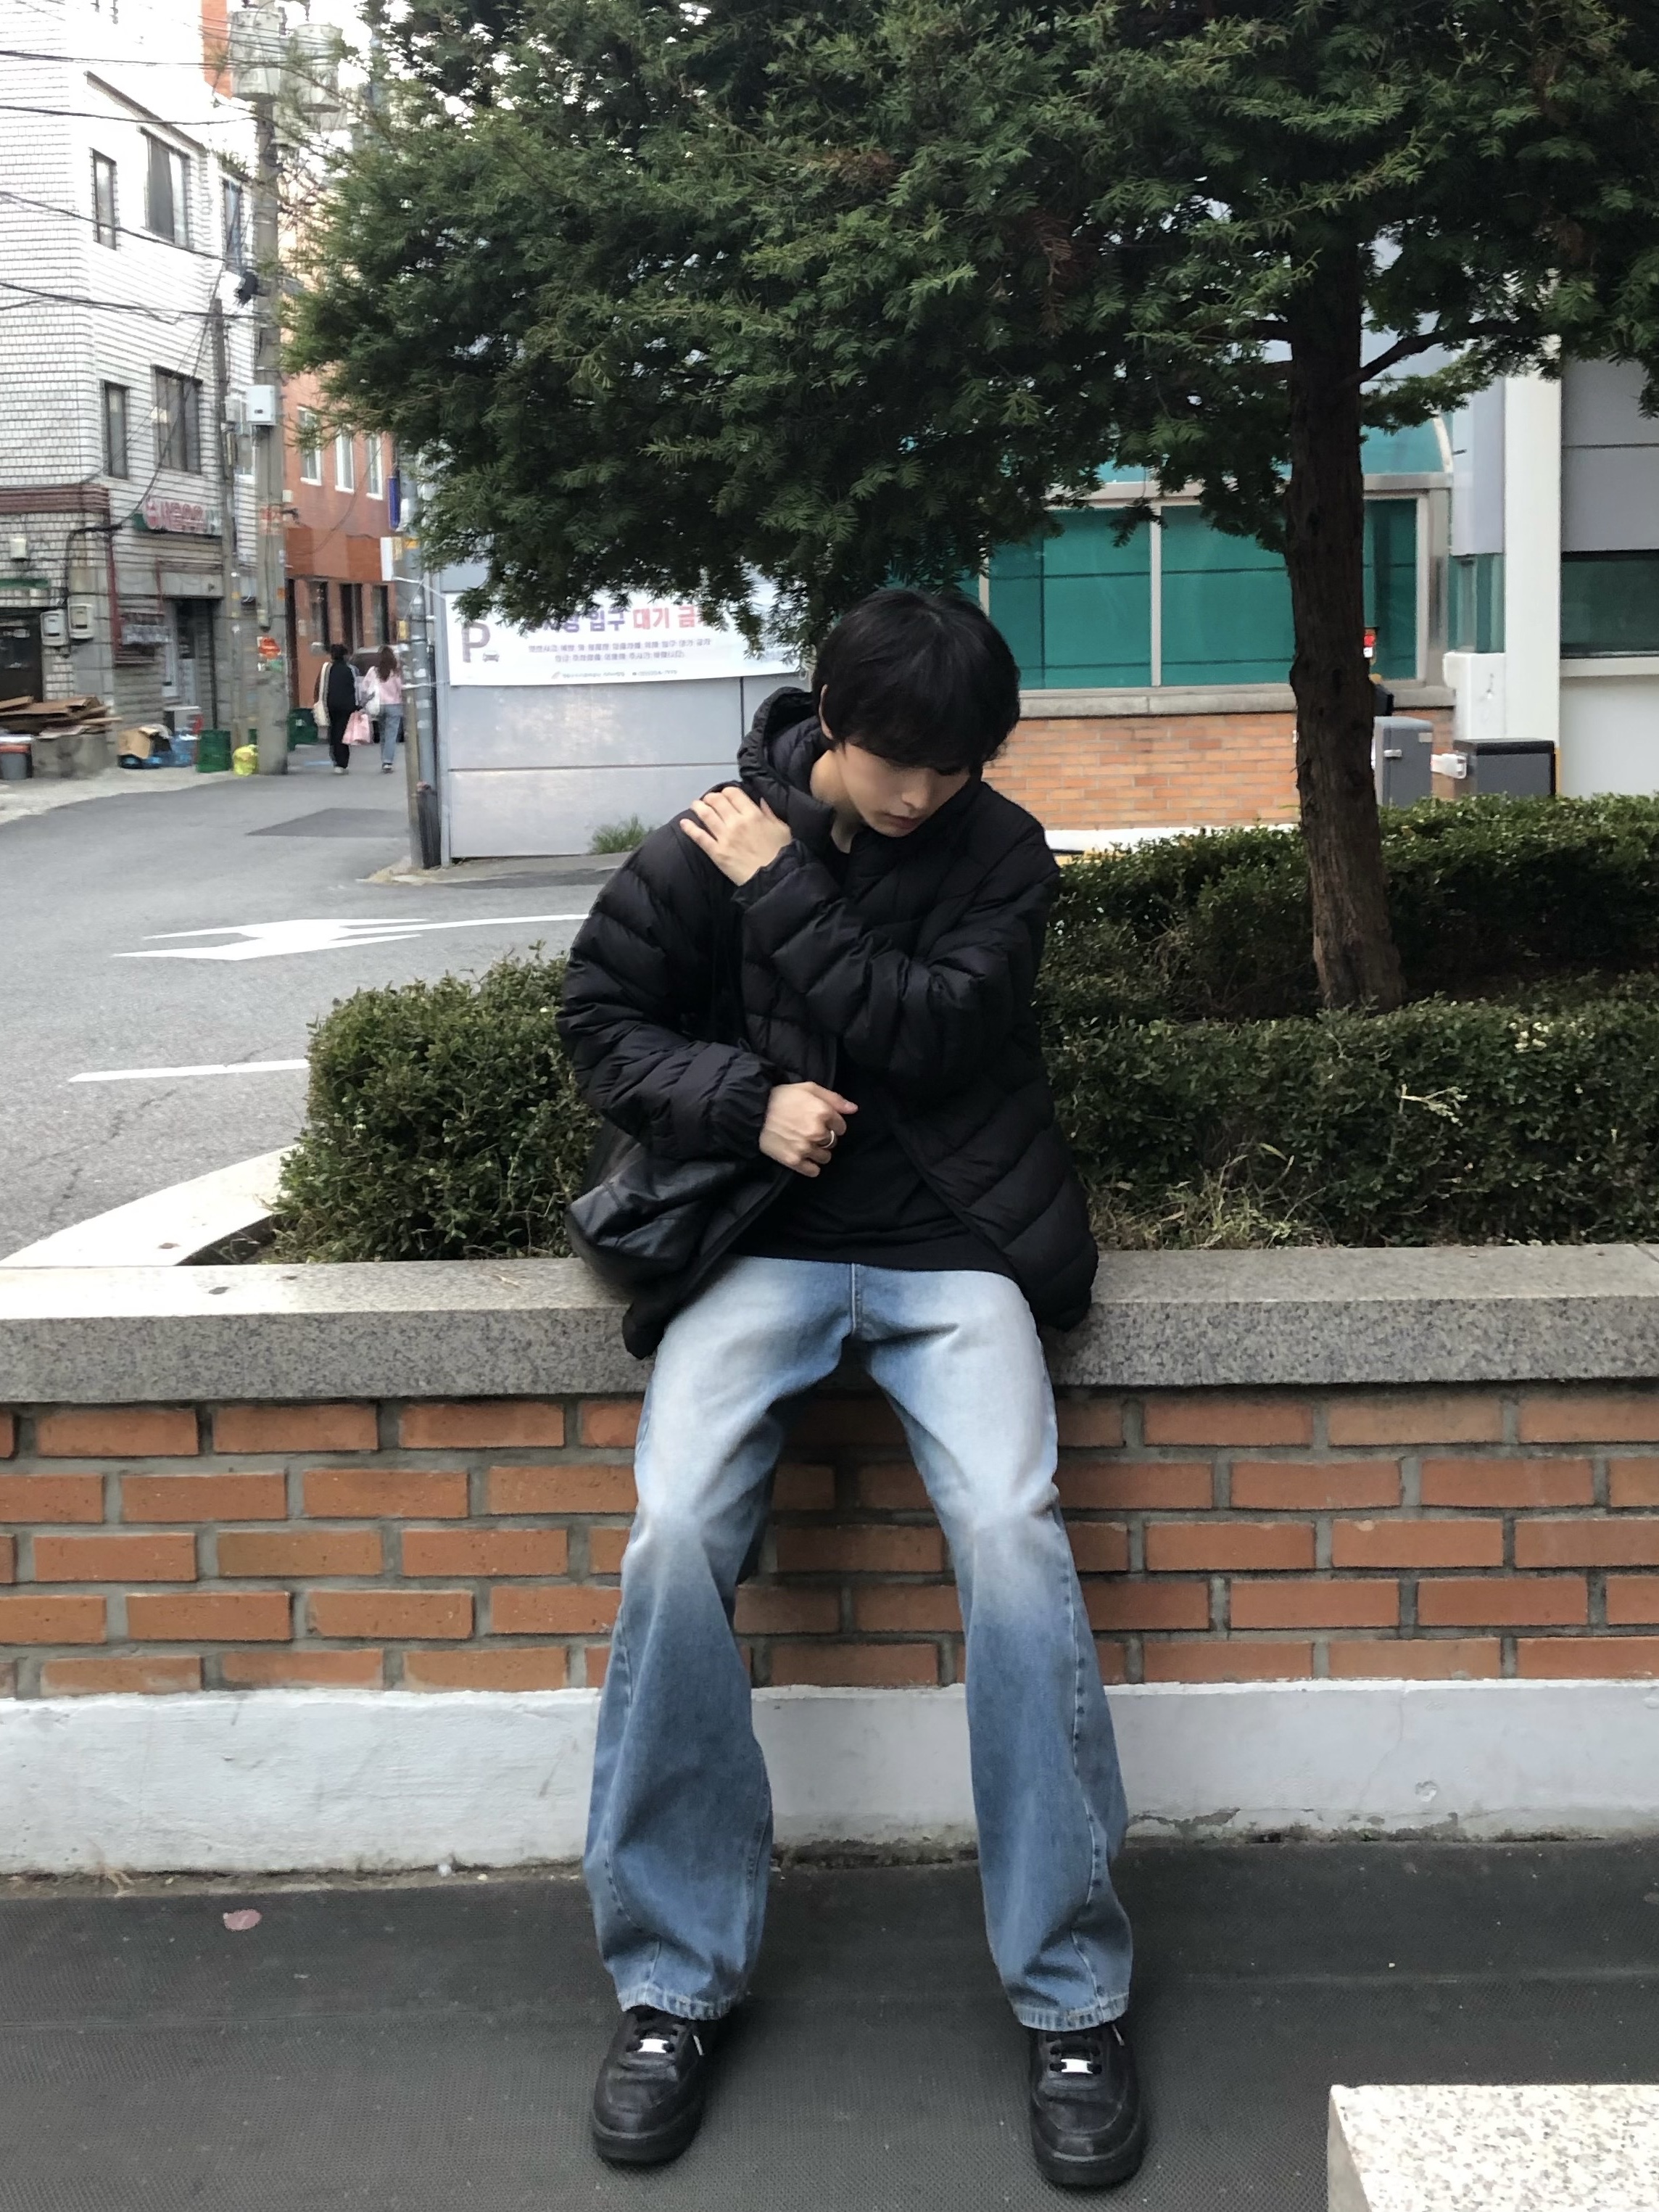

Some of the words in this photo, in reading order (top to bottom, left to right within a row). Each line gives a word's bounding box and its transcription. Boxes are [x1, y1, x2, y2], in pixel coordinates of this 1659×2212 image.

[589, 607, 625, 632] 입구
[633, 608, 670, 630] 대기
[461, 621, 491, 663] P
